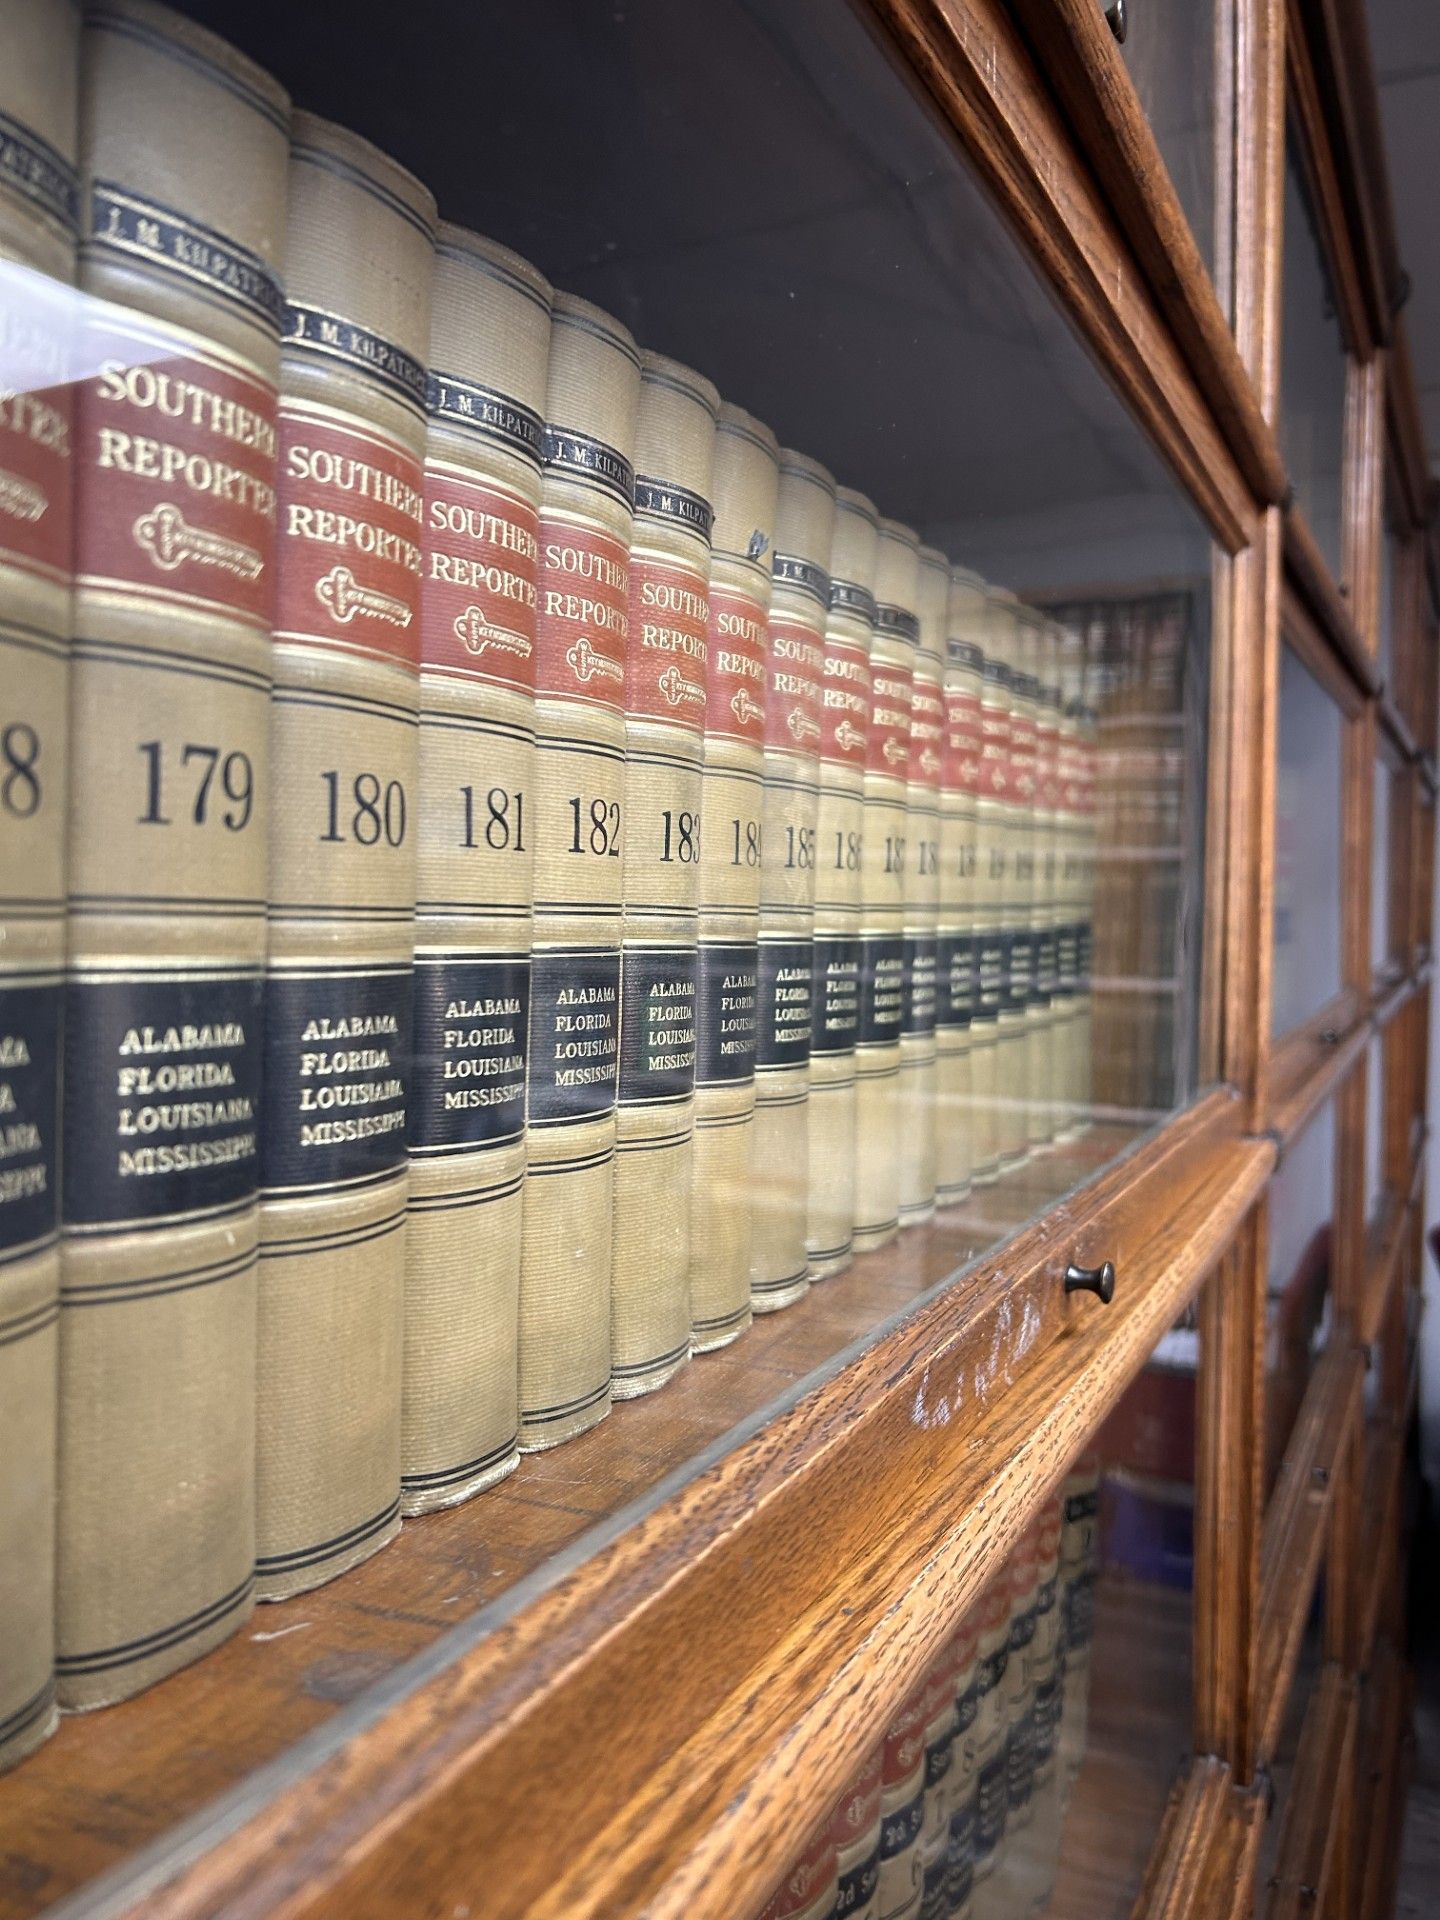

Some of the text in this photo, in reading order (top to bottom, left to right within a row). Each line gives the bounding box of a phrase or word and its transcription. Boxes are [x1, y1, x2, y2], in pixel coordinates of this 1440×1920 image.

[556, 441, 567, 460] J.
[138, 740, 255, 832] 179
[319, 771, 406, 847] 180
[459, 786, 526, 852] 181
[568, 797, 620, 857] 182
[445, 998, 521, 1018] ALABAMA
[556, 987, 616, 1005] ALABAMA
[555, 1013, 612, 1032] FLORIDA
[648, 1005, 693, 1022] FLORIDA
[119, 1022, 246, 1056] ALABAMA
[301, 1014, 399, 1041] ALABAMA
[443, 1027, 516, 1049] FLORIDA
[299, 1049, 391, 1076] FLORIDA
[443, 1055, 525, 1079] LOUISIANA
[117, 1062, 236, 1096] FLORIDA
[299, 1079, 404, 1111] LOUISIANA
[117, 1098, 254, 1136] LOUISIANA
